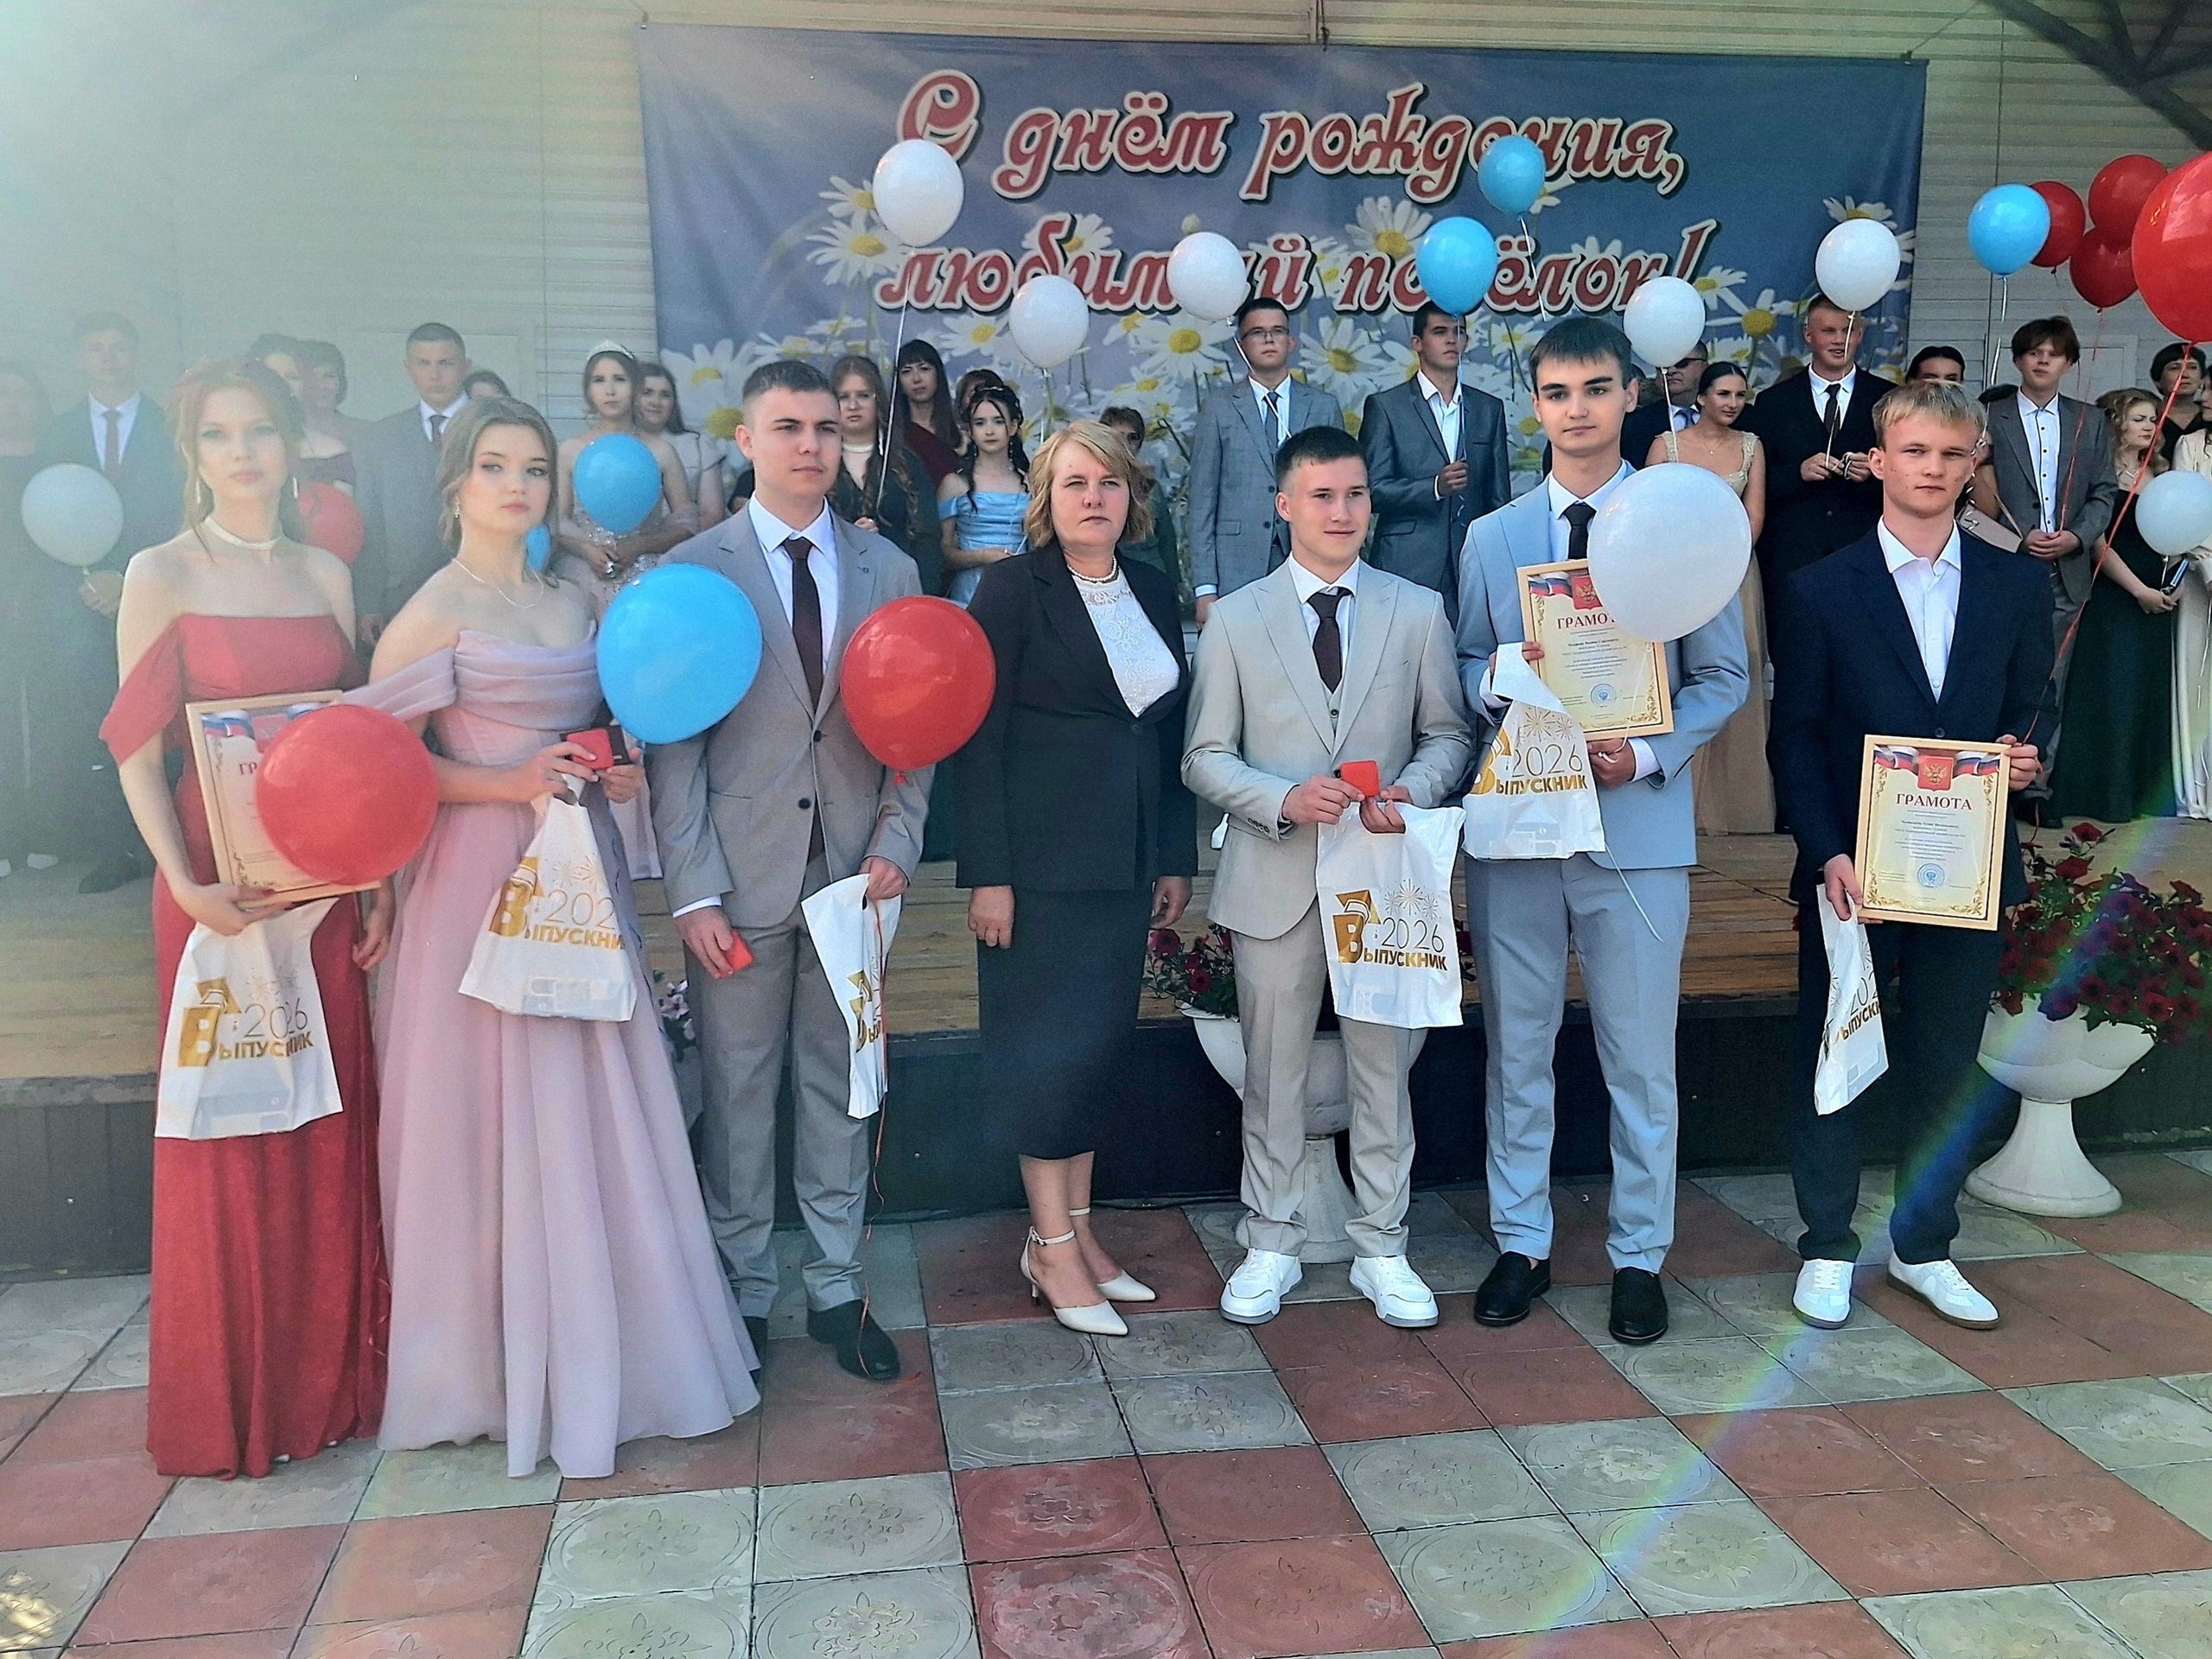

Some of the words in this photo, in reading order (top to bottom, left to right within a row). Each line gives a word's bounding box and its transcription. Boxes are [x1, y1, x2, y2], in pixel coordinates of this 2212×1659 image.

[897, 69, 980, 162] С
[992, 92, 1235, 200] днём
[875, 213, 1313, 312] любимй
[1557, 613, 1615, 629] ГРАМО
[1511, 743, 1583, 778] 2026
[1896, 793, 1973, 810] ГРАМОТА
[543, 889, 616, 930] 202
[1332, 913, 1448, 971] ВЫПУСКНИК
[1381, 917, 1445, 953] 2026
